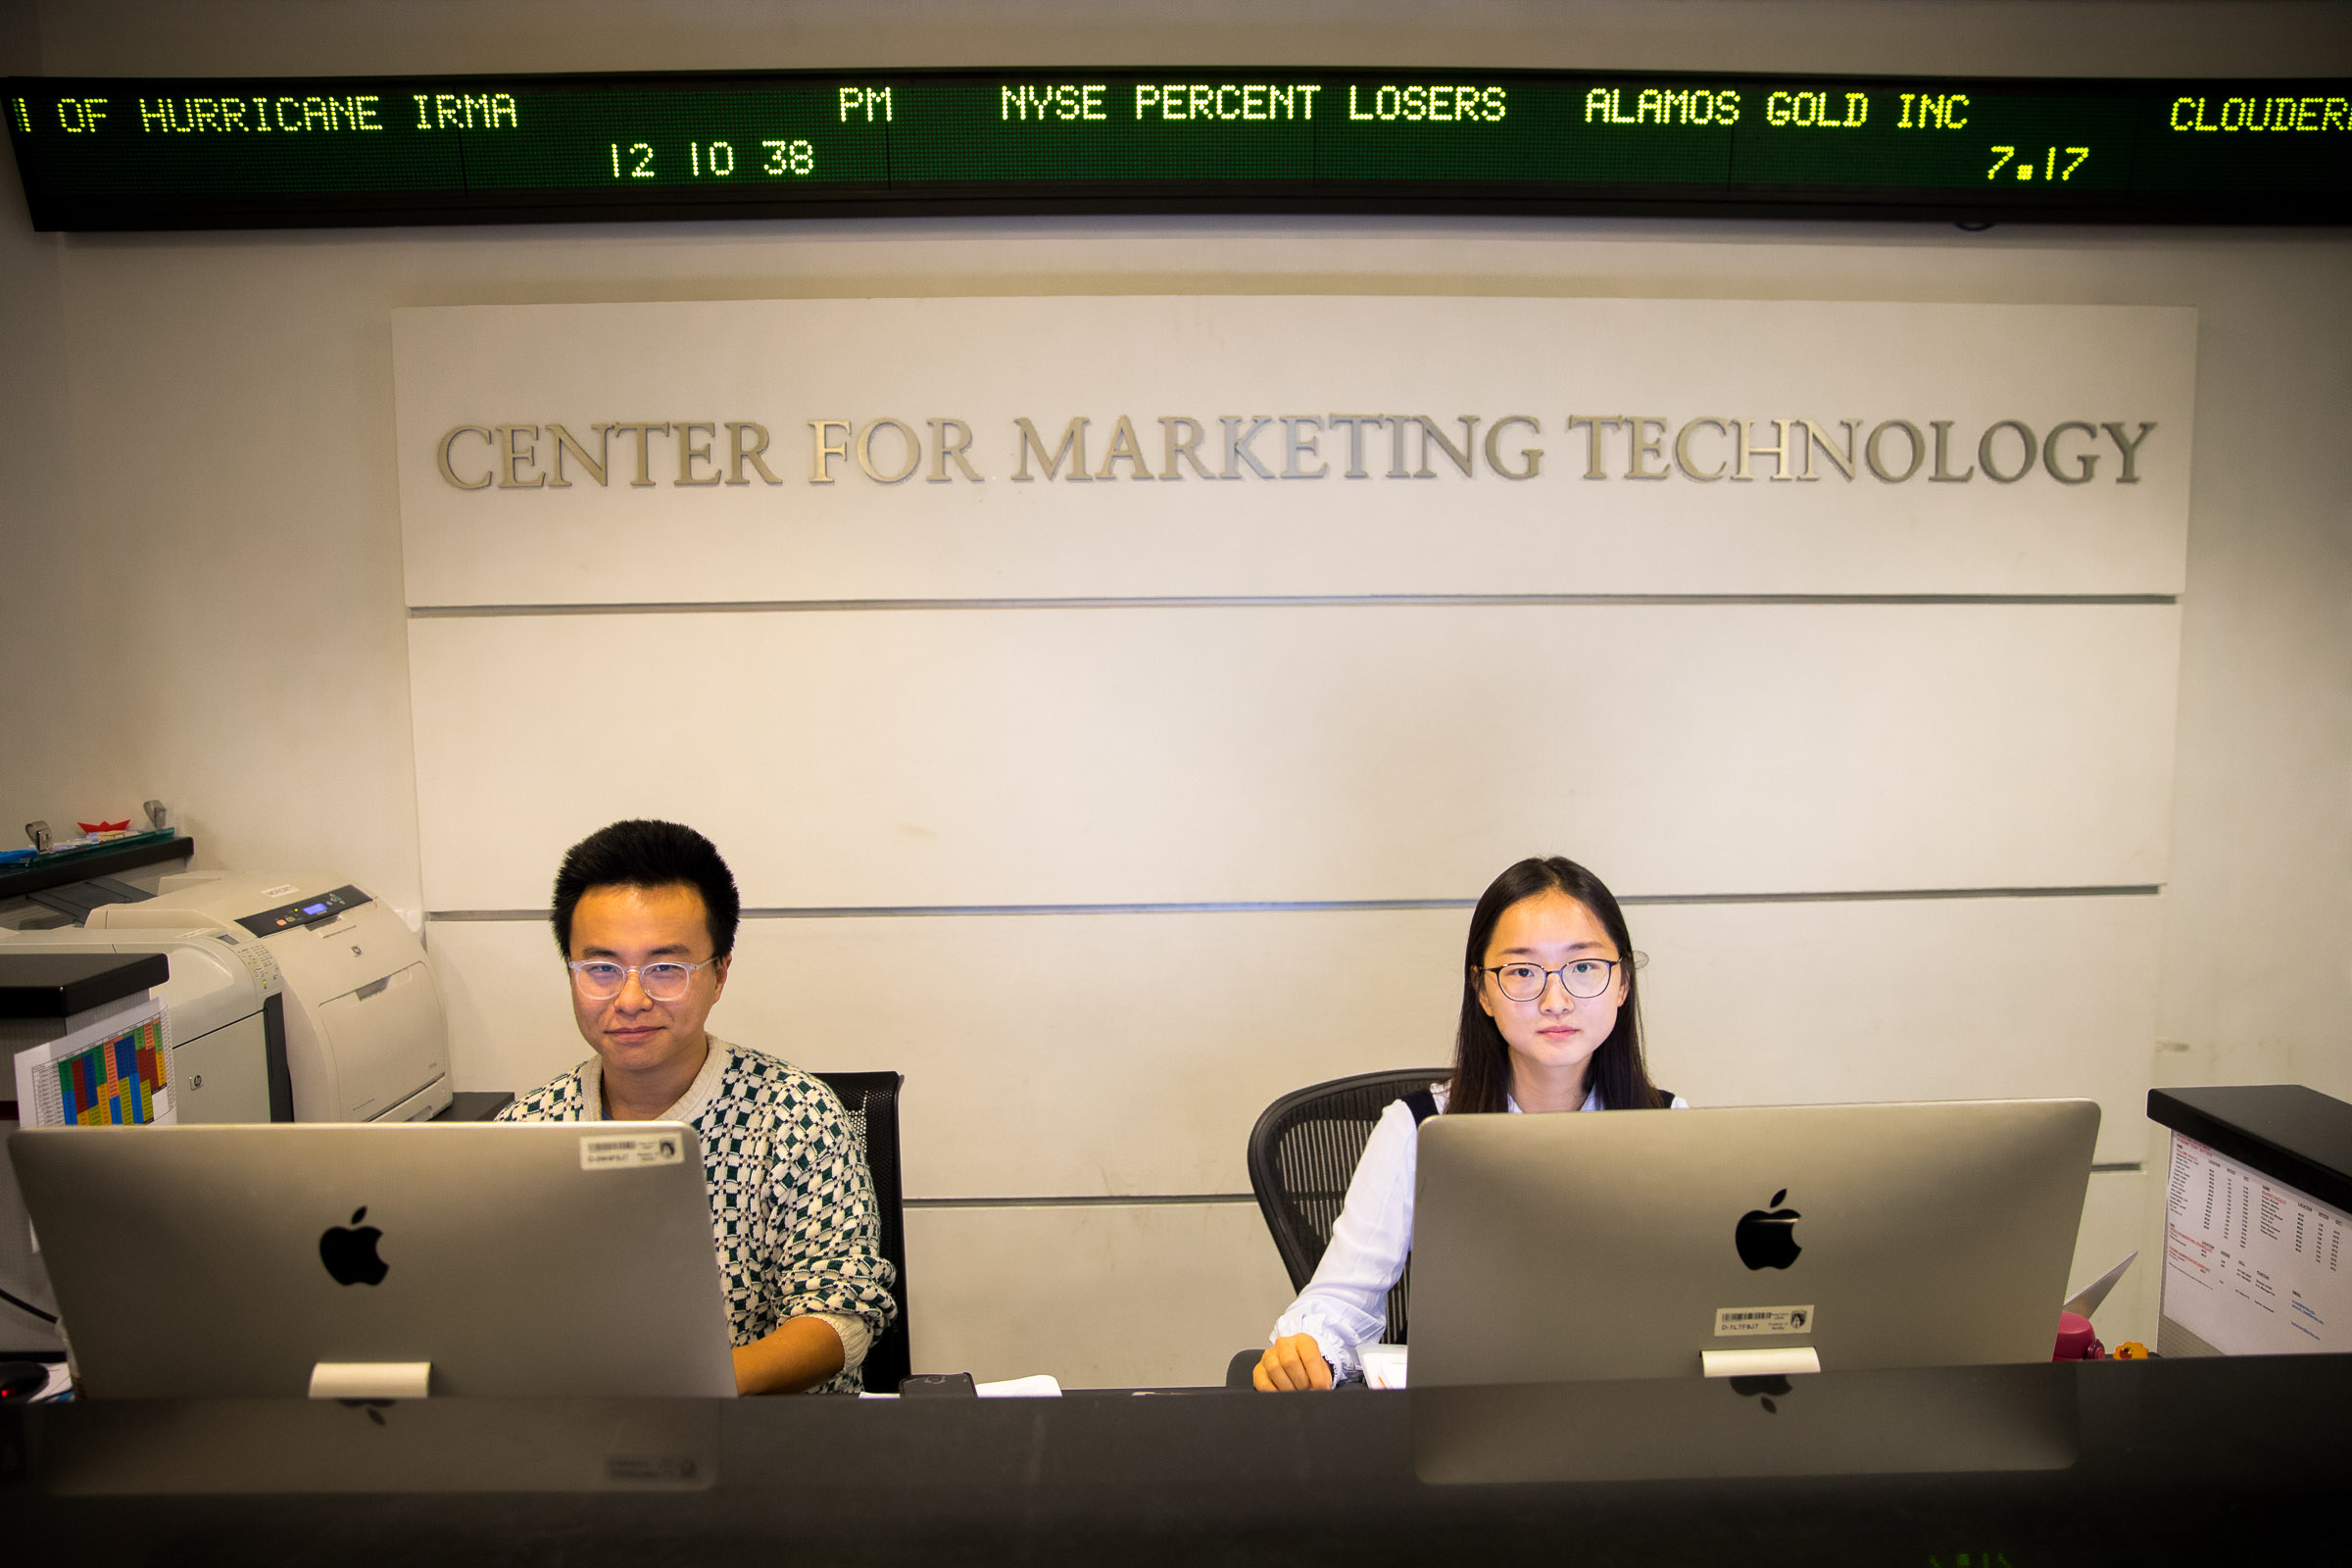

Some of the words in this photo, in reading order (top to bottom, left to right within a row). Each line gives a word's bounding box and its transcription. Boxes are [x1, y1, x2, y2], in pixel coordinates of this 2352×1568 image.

[57, 98, 108, 133] OF
[138, 95, 383, 133] HURRICANE
[413, 93, 518, 130] IRMA
[839, 86, 893, 123] PM
[1001, 84, 1107, 122] NYSE
[1135, 84, 1322, 121] PERCENT
[1348, 84, 1507, 122] LOSERS
[1584, 87, 1741, 125] ALAMOS
[1765, 90, 1869, 127] GOLD
[1896, 93, 1971, 129] INC
[2170, 96, 2352, 132] CLOUDER
[611, 142, 656, 178] 12
[690, 140, 735, 177] 10
[761, 139, 814, 176] 38
[1986, 145, 2089, 181] 7.17
[437, 421, 783, 491] CENTER
[807, 416, 986, 485] FOR
[1010, 413, 1545, 481] MARKETING
[1567, 414, 2159, 486] TECHNOLOGY
